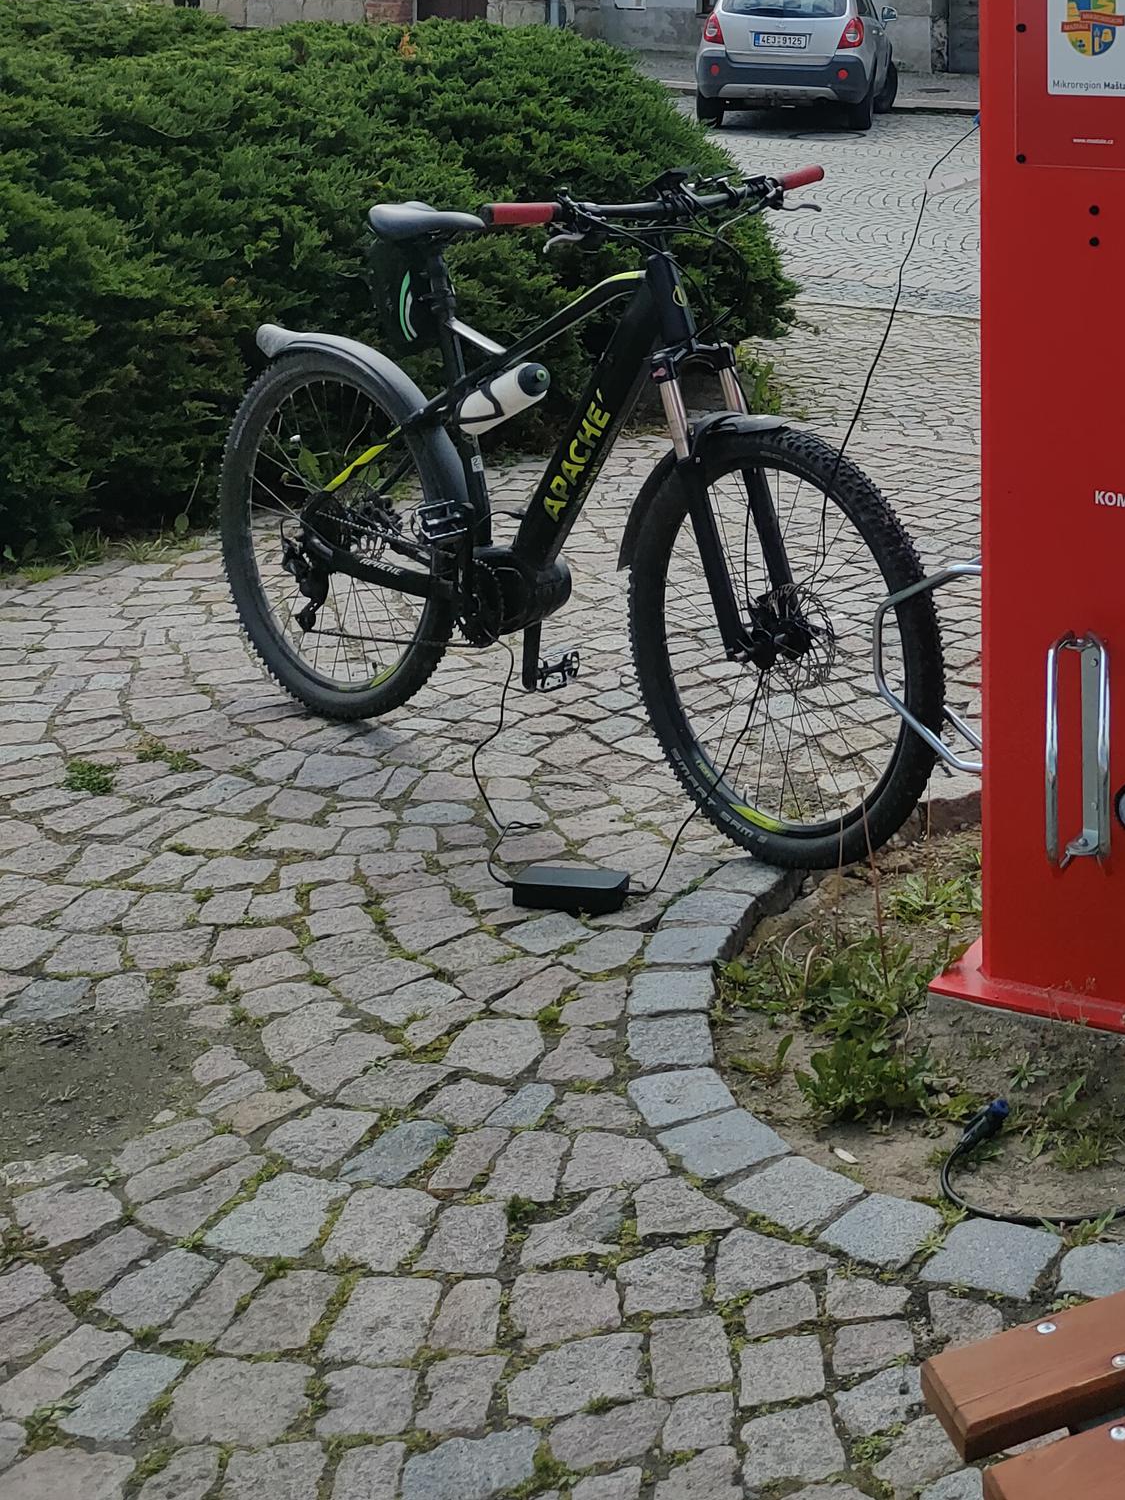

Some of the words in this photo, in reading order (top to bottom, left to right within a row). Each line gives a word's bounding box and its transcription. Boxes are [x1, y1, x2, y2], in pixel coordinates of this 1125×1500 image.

[761, 35, 777, 45] 4E3
[782, 36, 802, 45] 9125
[1052, 79, 1102, 92] Mikroregion
